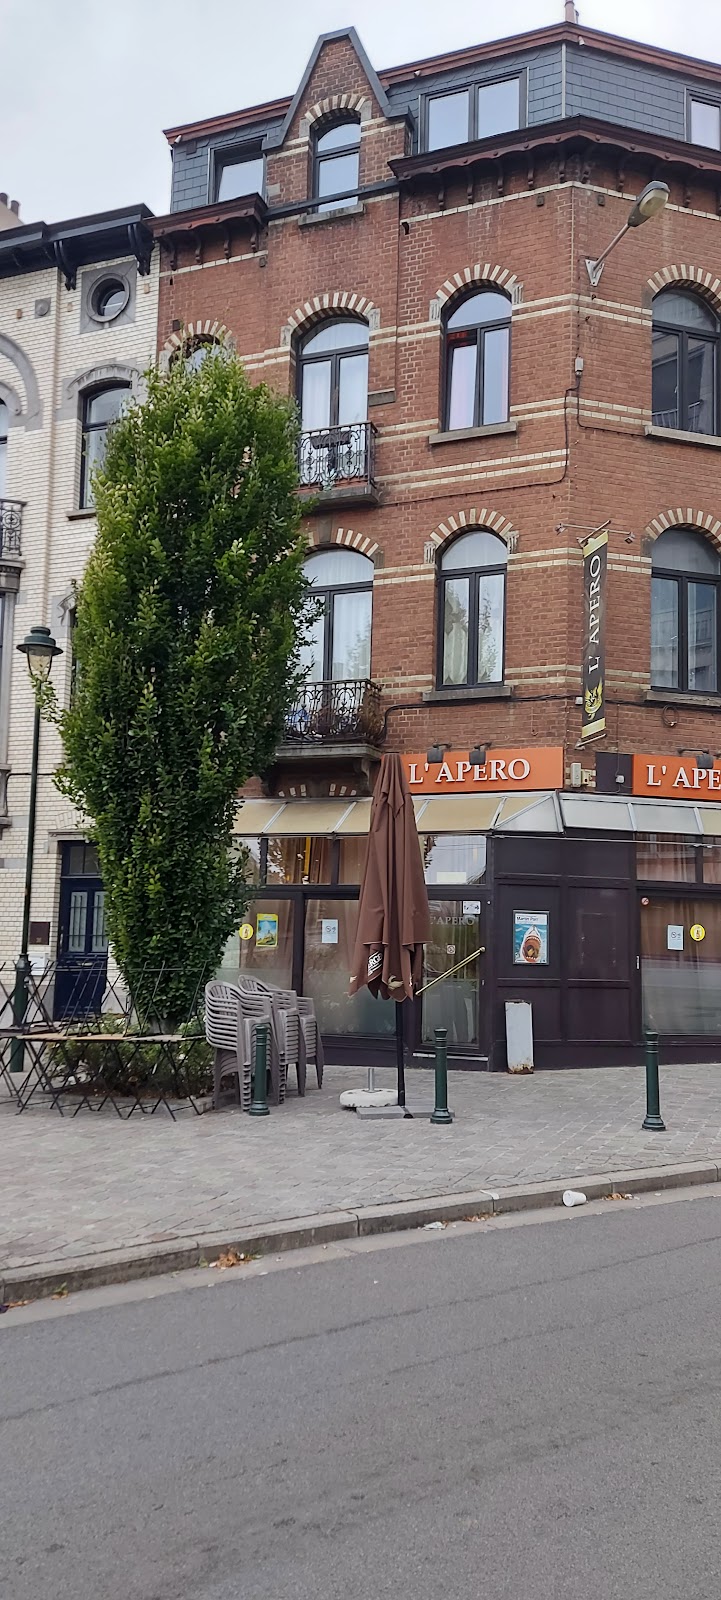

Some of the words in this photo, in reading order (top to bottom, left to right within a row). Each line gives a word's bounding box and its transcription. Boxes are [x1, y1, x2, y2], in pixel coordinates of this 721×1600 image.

[589, 555, 601, 645] APERO
[408, 763, 429, 784] L'
[435, 758, 531, 783] APERO
[646, 764, 667, 786] L'
[672, 767, 721, 790] APE
